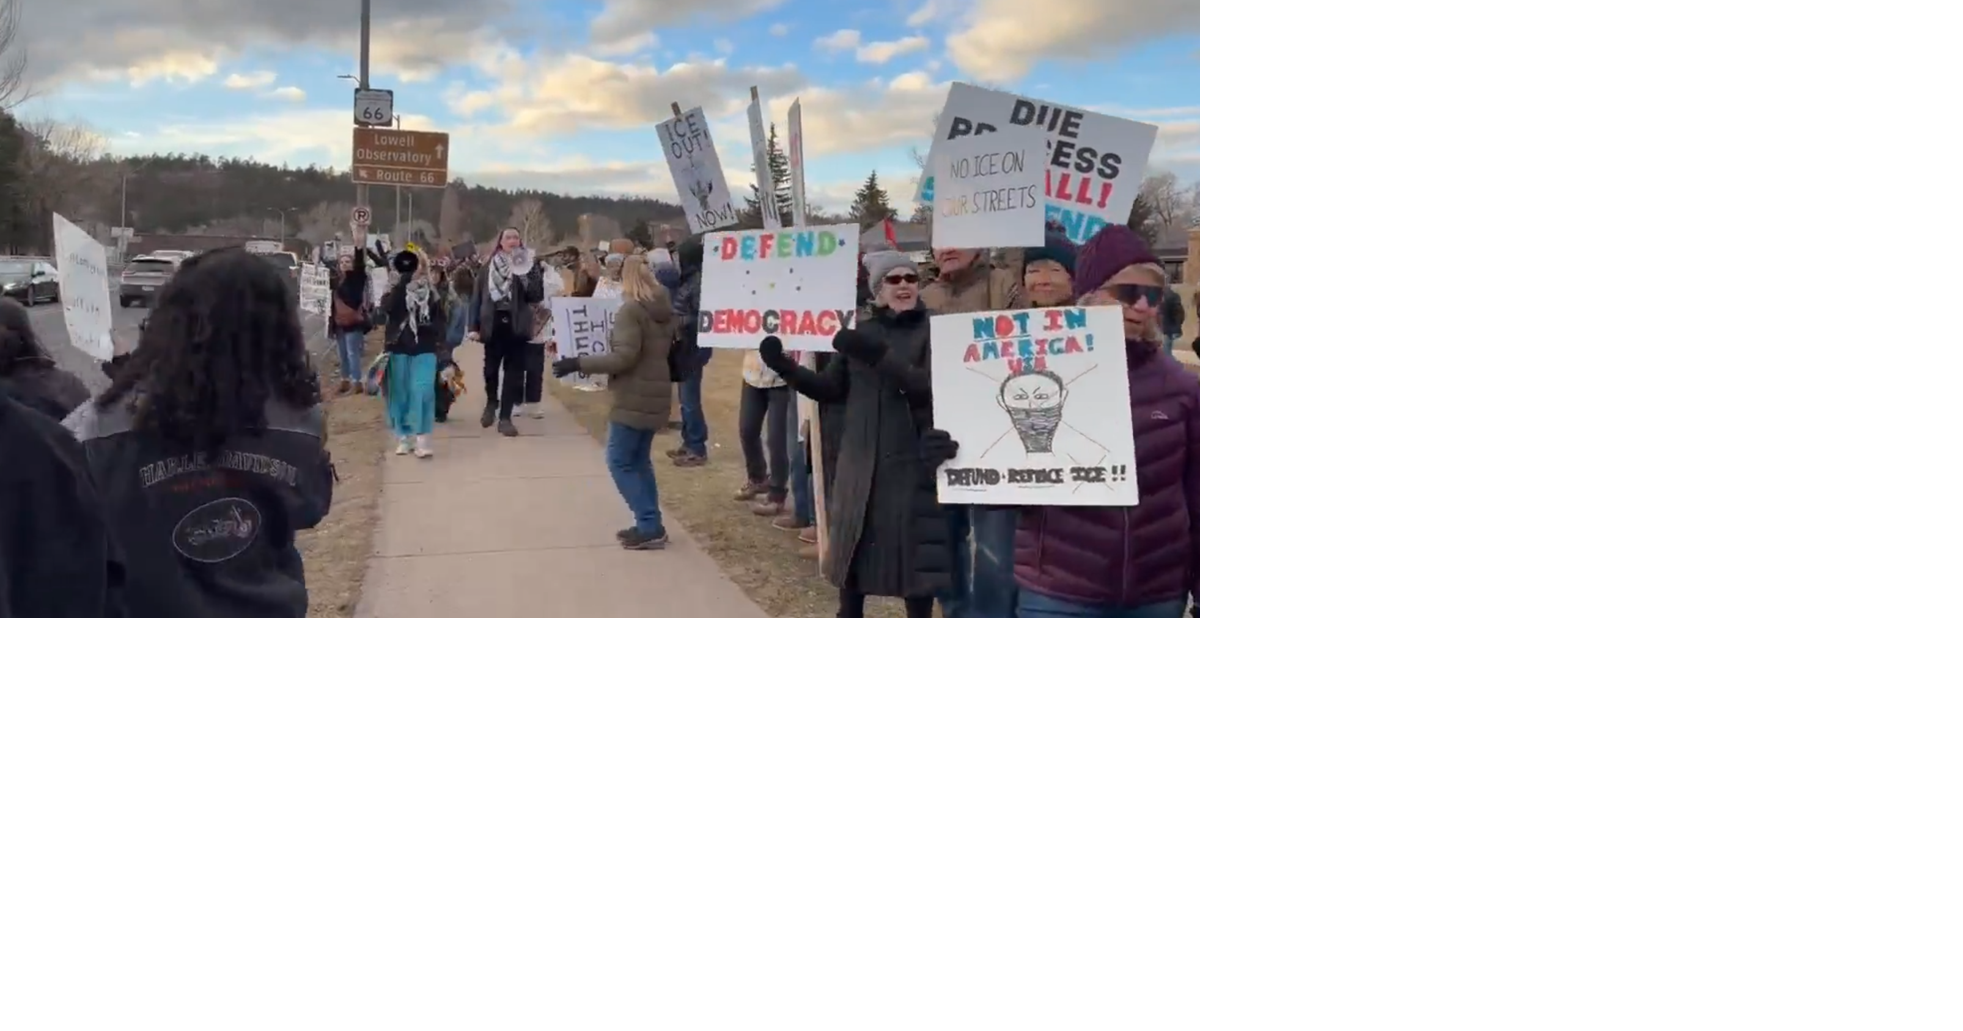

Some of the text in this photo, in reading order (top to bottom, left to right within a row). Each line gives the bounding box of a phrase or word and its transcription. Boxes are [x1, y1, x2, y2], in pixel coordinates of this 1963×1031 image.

[363, 106, 384, 121] 66
[665, 113, 700, 142] ICE
[1009, 98, 1084, 139] DUE
[374, 133, 415, 147] Lowell
[671, 129, 709, 160] OUT!
[356, 148, 432, 166] Observatory
[950, 149, 1026, 179] NO ICE ON
[376, 169, 435, 184] Route 66
[971, 184, 1038, 214] STREETS
[696, 202, 735, 229] NOW!
[721, 230, 837, 261] DEFEND
[698, 308, 855, 336] DEMOCRACY
[973, 307, 1087, 339] NOT IN
[963, 333, 1095, 363] AMERICA!
